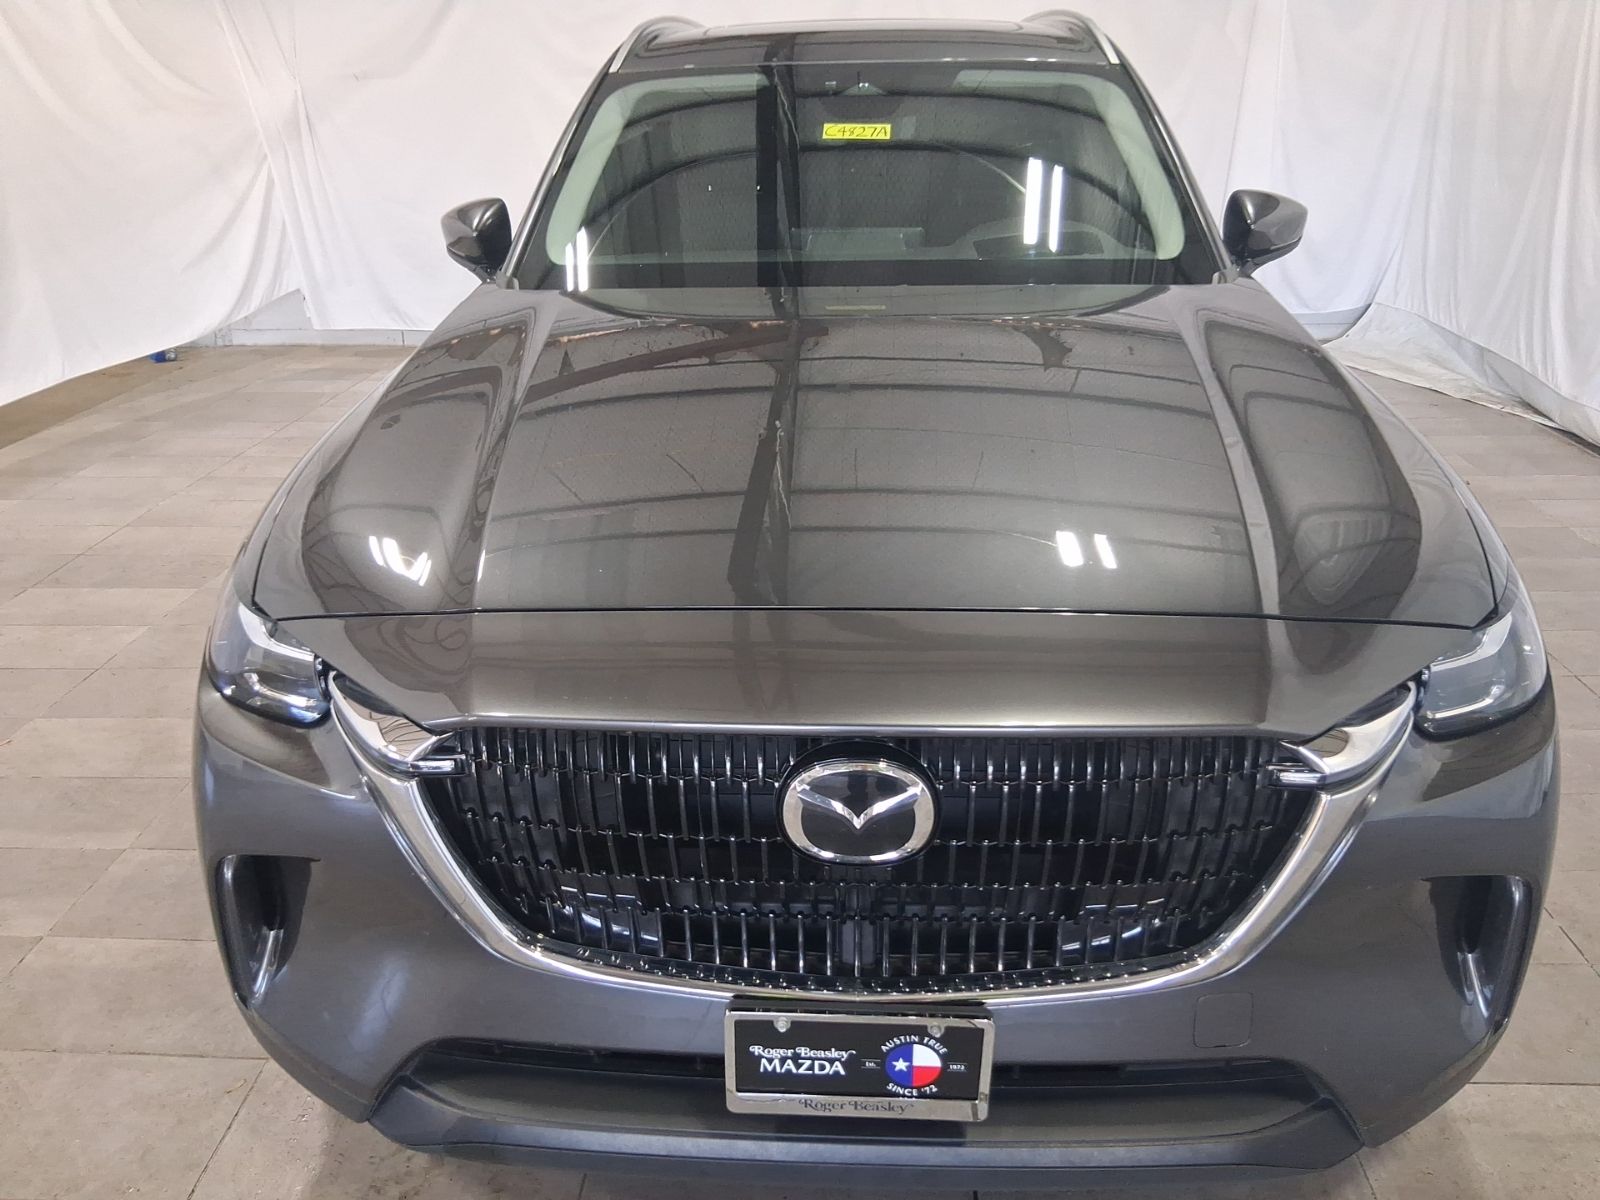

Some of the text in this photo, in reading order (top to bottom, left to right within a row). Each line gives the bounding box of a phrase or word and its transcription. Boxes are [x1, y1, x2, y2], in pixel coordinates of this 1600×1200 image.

[824, 125, 888, 138] C4827A
[880, 1034, 948, 1054] AUSTIN TRUE
[749, 1045, 857, 1061] Roger Beasley
[760, 1058, 846, 1075] MAZDA
[886, 1083, 938, 1096] SINCE '72
[798, 1098, 914, 1115] Roger Beasley
